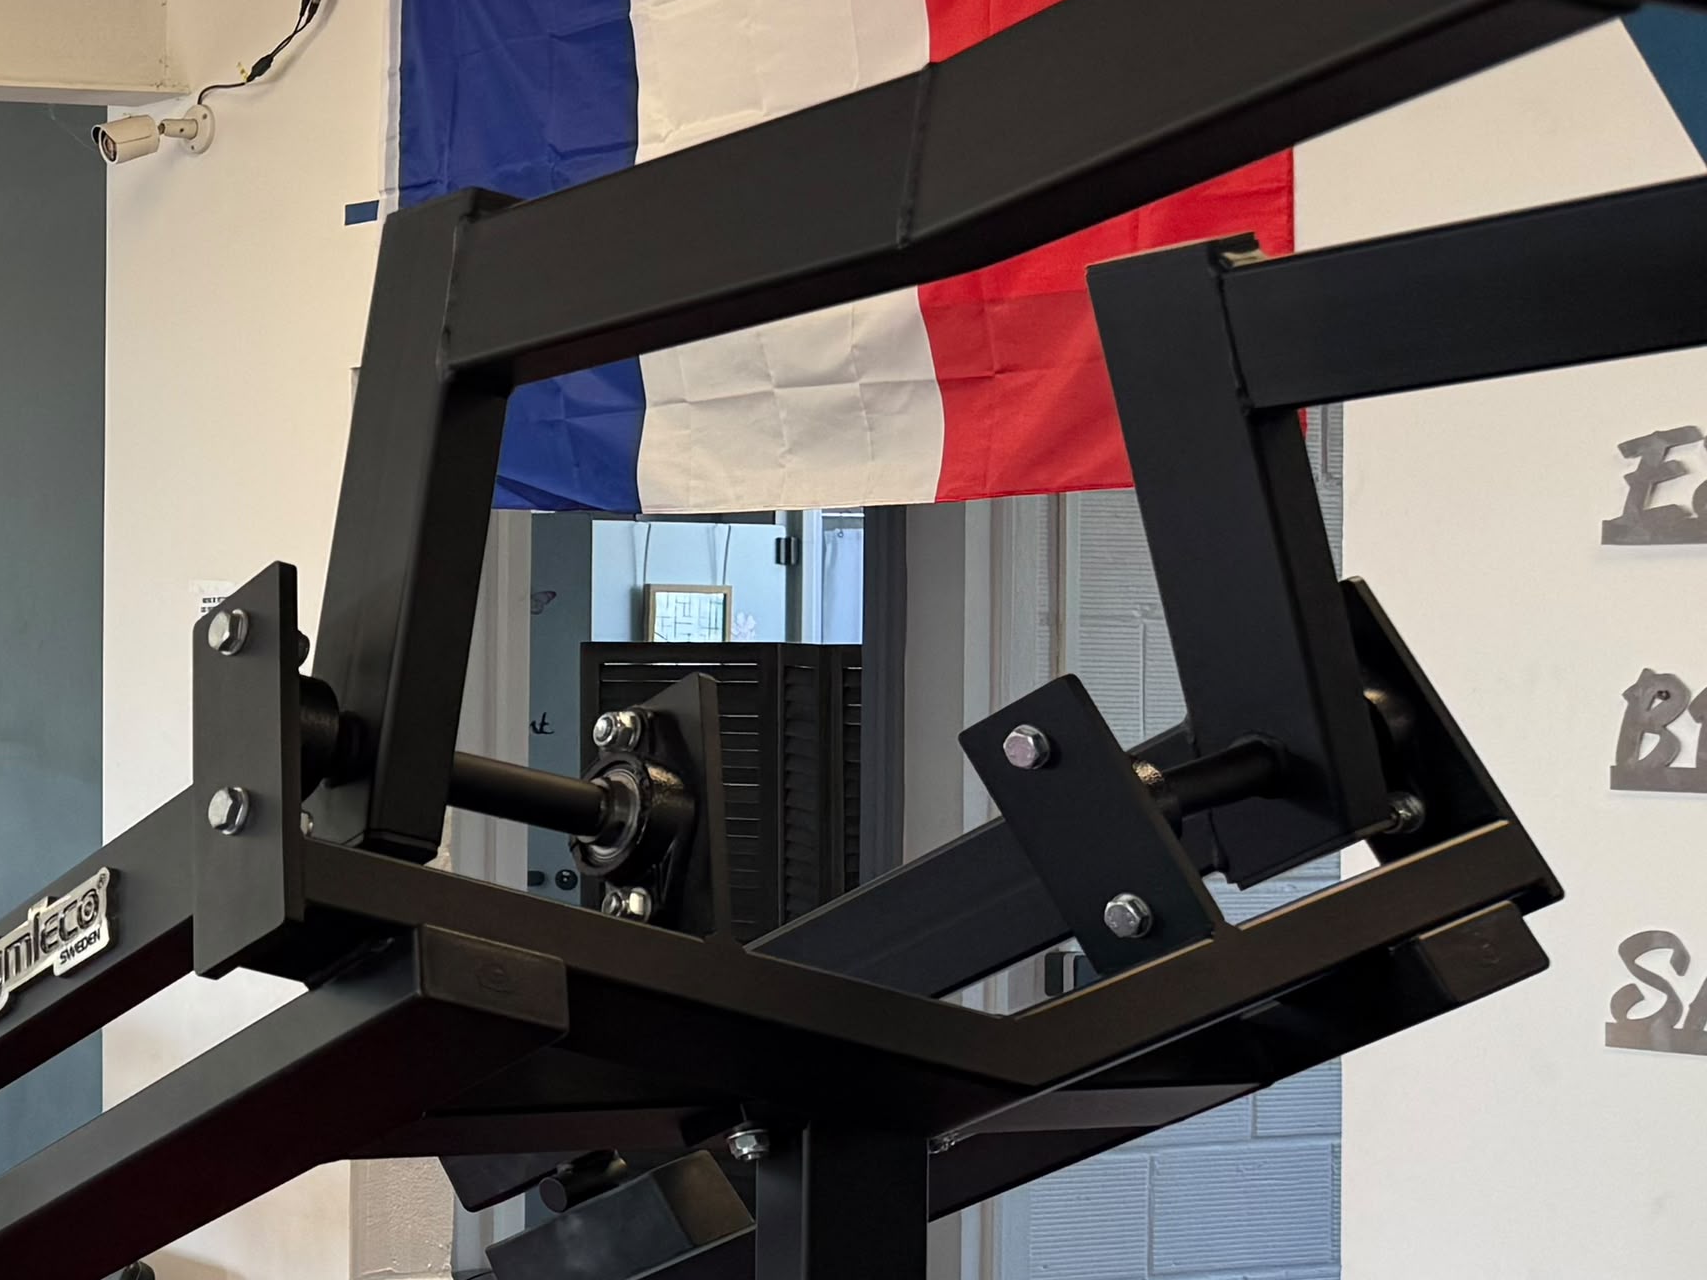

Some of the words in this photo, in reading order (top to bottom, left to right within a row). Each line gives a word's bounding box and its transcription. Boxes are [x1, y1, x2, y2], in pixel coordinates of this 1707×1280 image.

[1615, 426, 1707, 522] E
[1614, 667, 1707, 767] B
[59, 928, 100, 965] SWEDEN
[1610, 929, 1707, 1025] S
